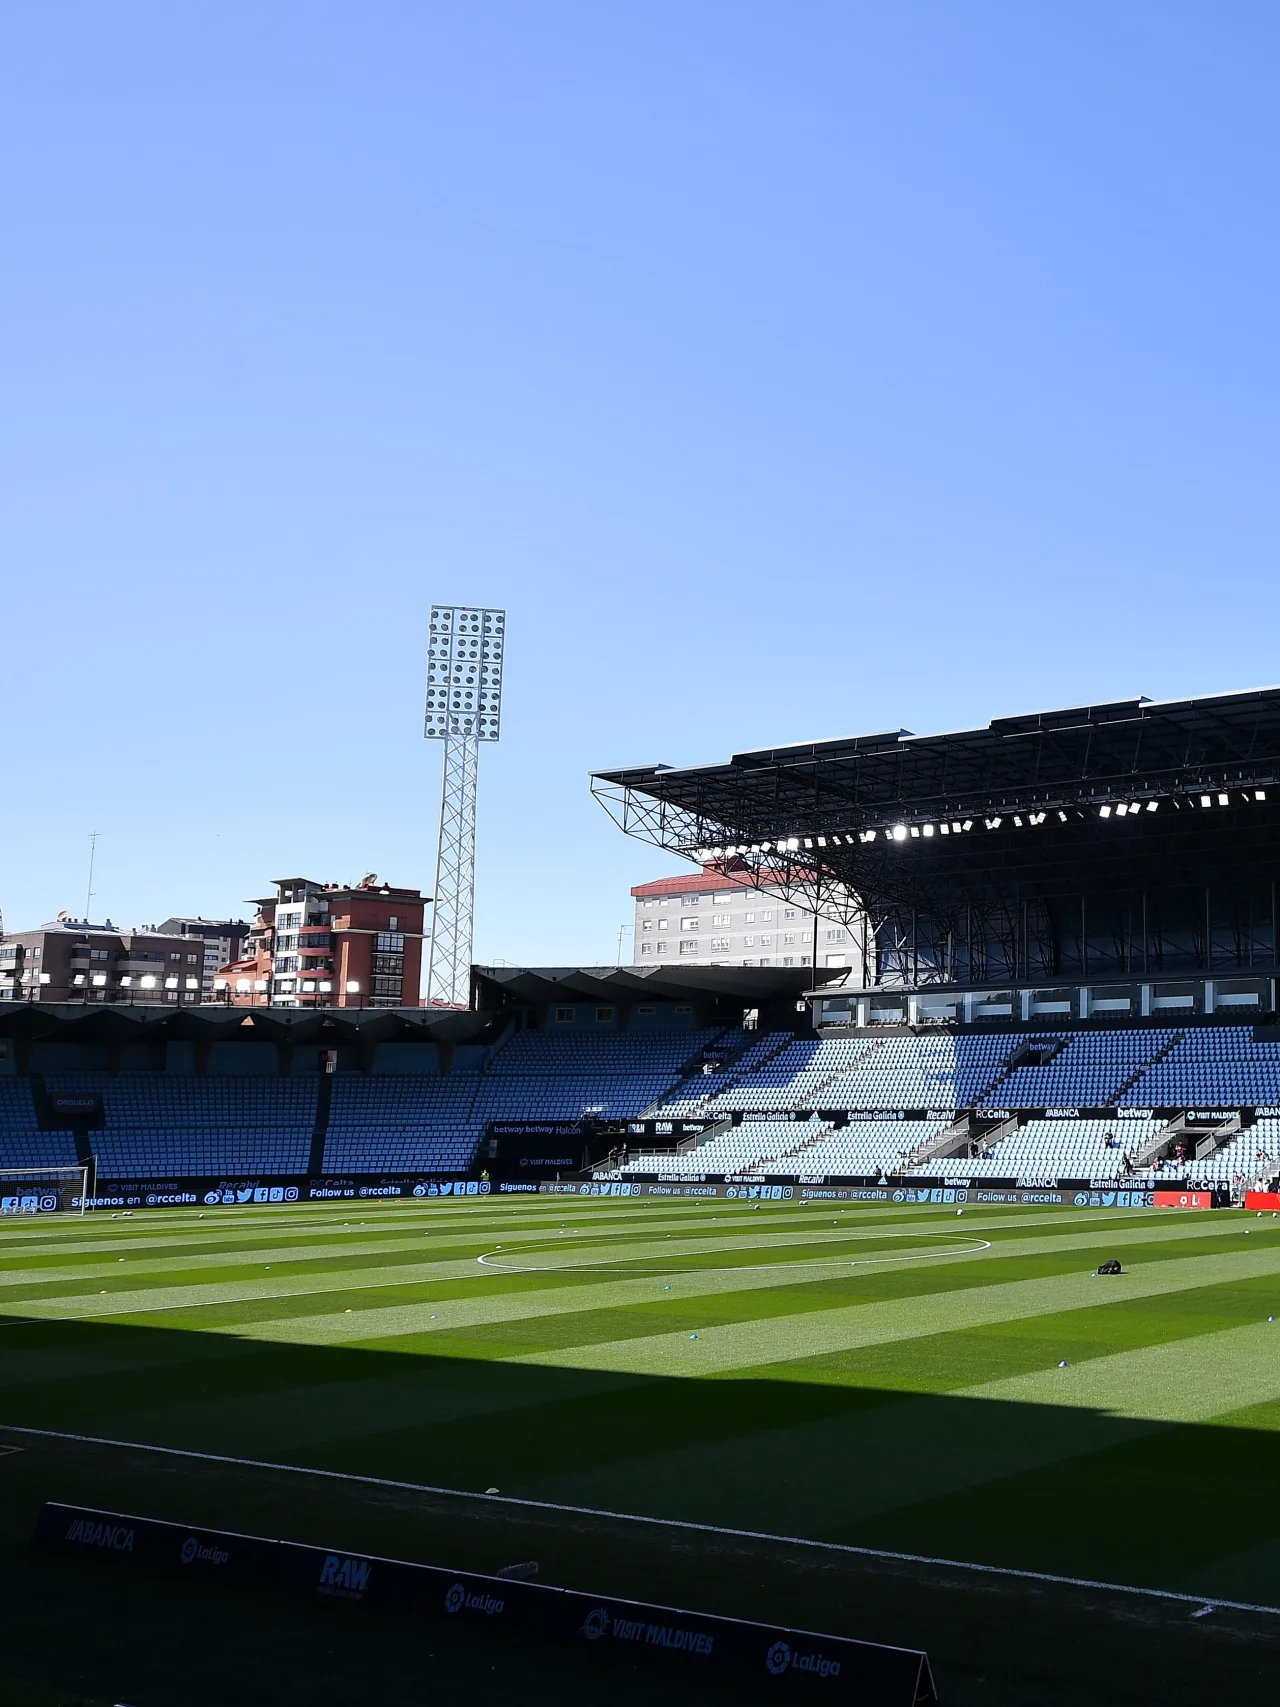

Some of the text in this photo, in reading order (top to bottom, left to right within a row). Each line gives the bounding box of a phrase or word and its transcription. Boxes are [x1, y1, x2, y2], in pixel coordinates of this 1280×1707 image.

[1029, 1042, 1056, 1051] betway
[703, 1112, 732, 1120] RCCelta
[743, 1112, 788, 1121] Estrella Galicia
[847, 1110, 897, 1121] Estrella Galicia
[926, 1109, 956, 1120] Recalvi
[976, 1109, 1010, 1119] RCCelta
[1045, 1108, 1080, 1117] ABANCA
[1117, 1107, 1153, 1119] betway
[1196, 1110, 1240, 1119] VISIT MALDIVES
[494, 1125, 553, 1134] betway betway
[655, 1122, 673, 1132] RAW
[683, 1123, 704, 1132] betway
[592, 1171, 622, 1181] ABANCA
[658, 1173, 700, 1182] Estrella Galicia
[731, 1175, 765, 1183] VISIT MALDIVES
[798, 1174, 825, 1184] Recalvi
[944, 1177, 971, 1187] betway
[1016, 1178, 1056, 1188] ABANCA
[1089, 1179, 1146, 1189] Estrella Galicia
[120, 1183, 178, 1192] VISIT MALDIVES
[310, 1186, 401, 1198] Follow us @rccelta
[499, 1182, 537, 1193] Síguenos
[648, 1186, 717, 1196] Follow us @rccelta
[127, 1196, 140, 1204] en
[146, 1193, 197, 1206] @rccelta
[801, 1189, 836, 1199] Síguenos
[850, 1190, 887, 1200] @rccelta
[977, 1192, 1062, 1203] Follow us @rccelta
[65, 1519, 135, 1552] ABANCA
[196, 1543, 229, 1564] LaLiga
[319, 1555, 370, 1591] RAW
[464, 1592, 504, 1615] LaLiga
[613, 1617, 714, 1656] VISIT MALDIVES
[792, 1652, 841, 1677] LaLiga
